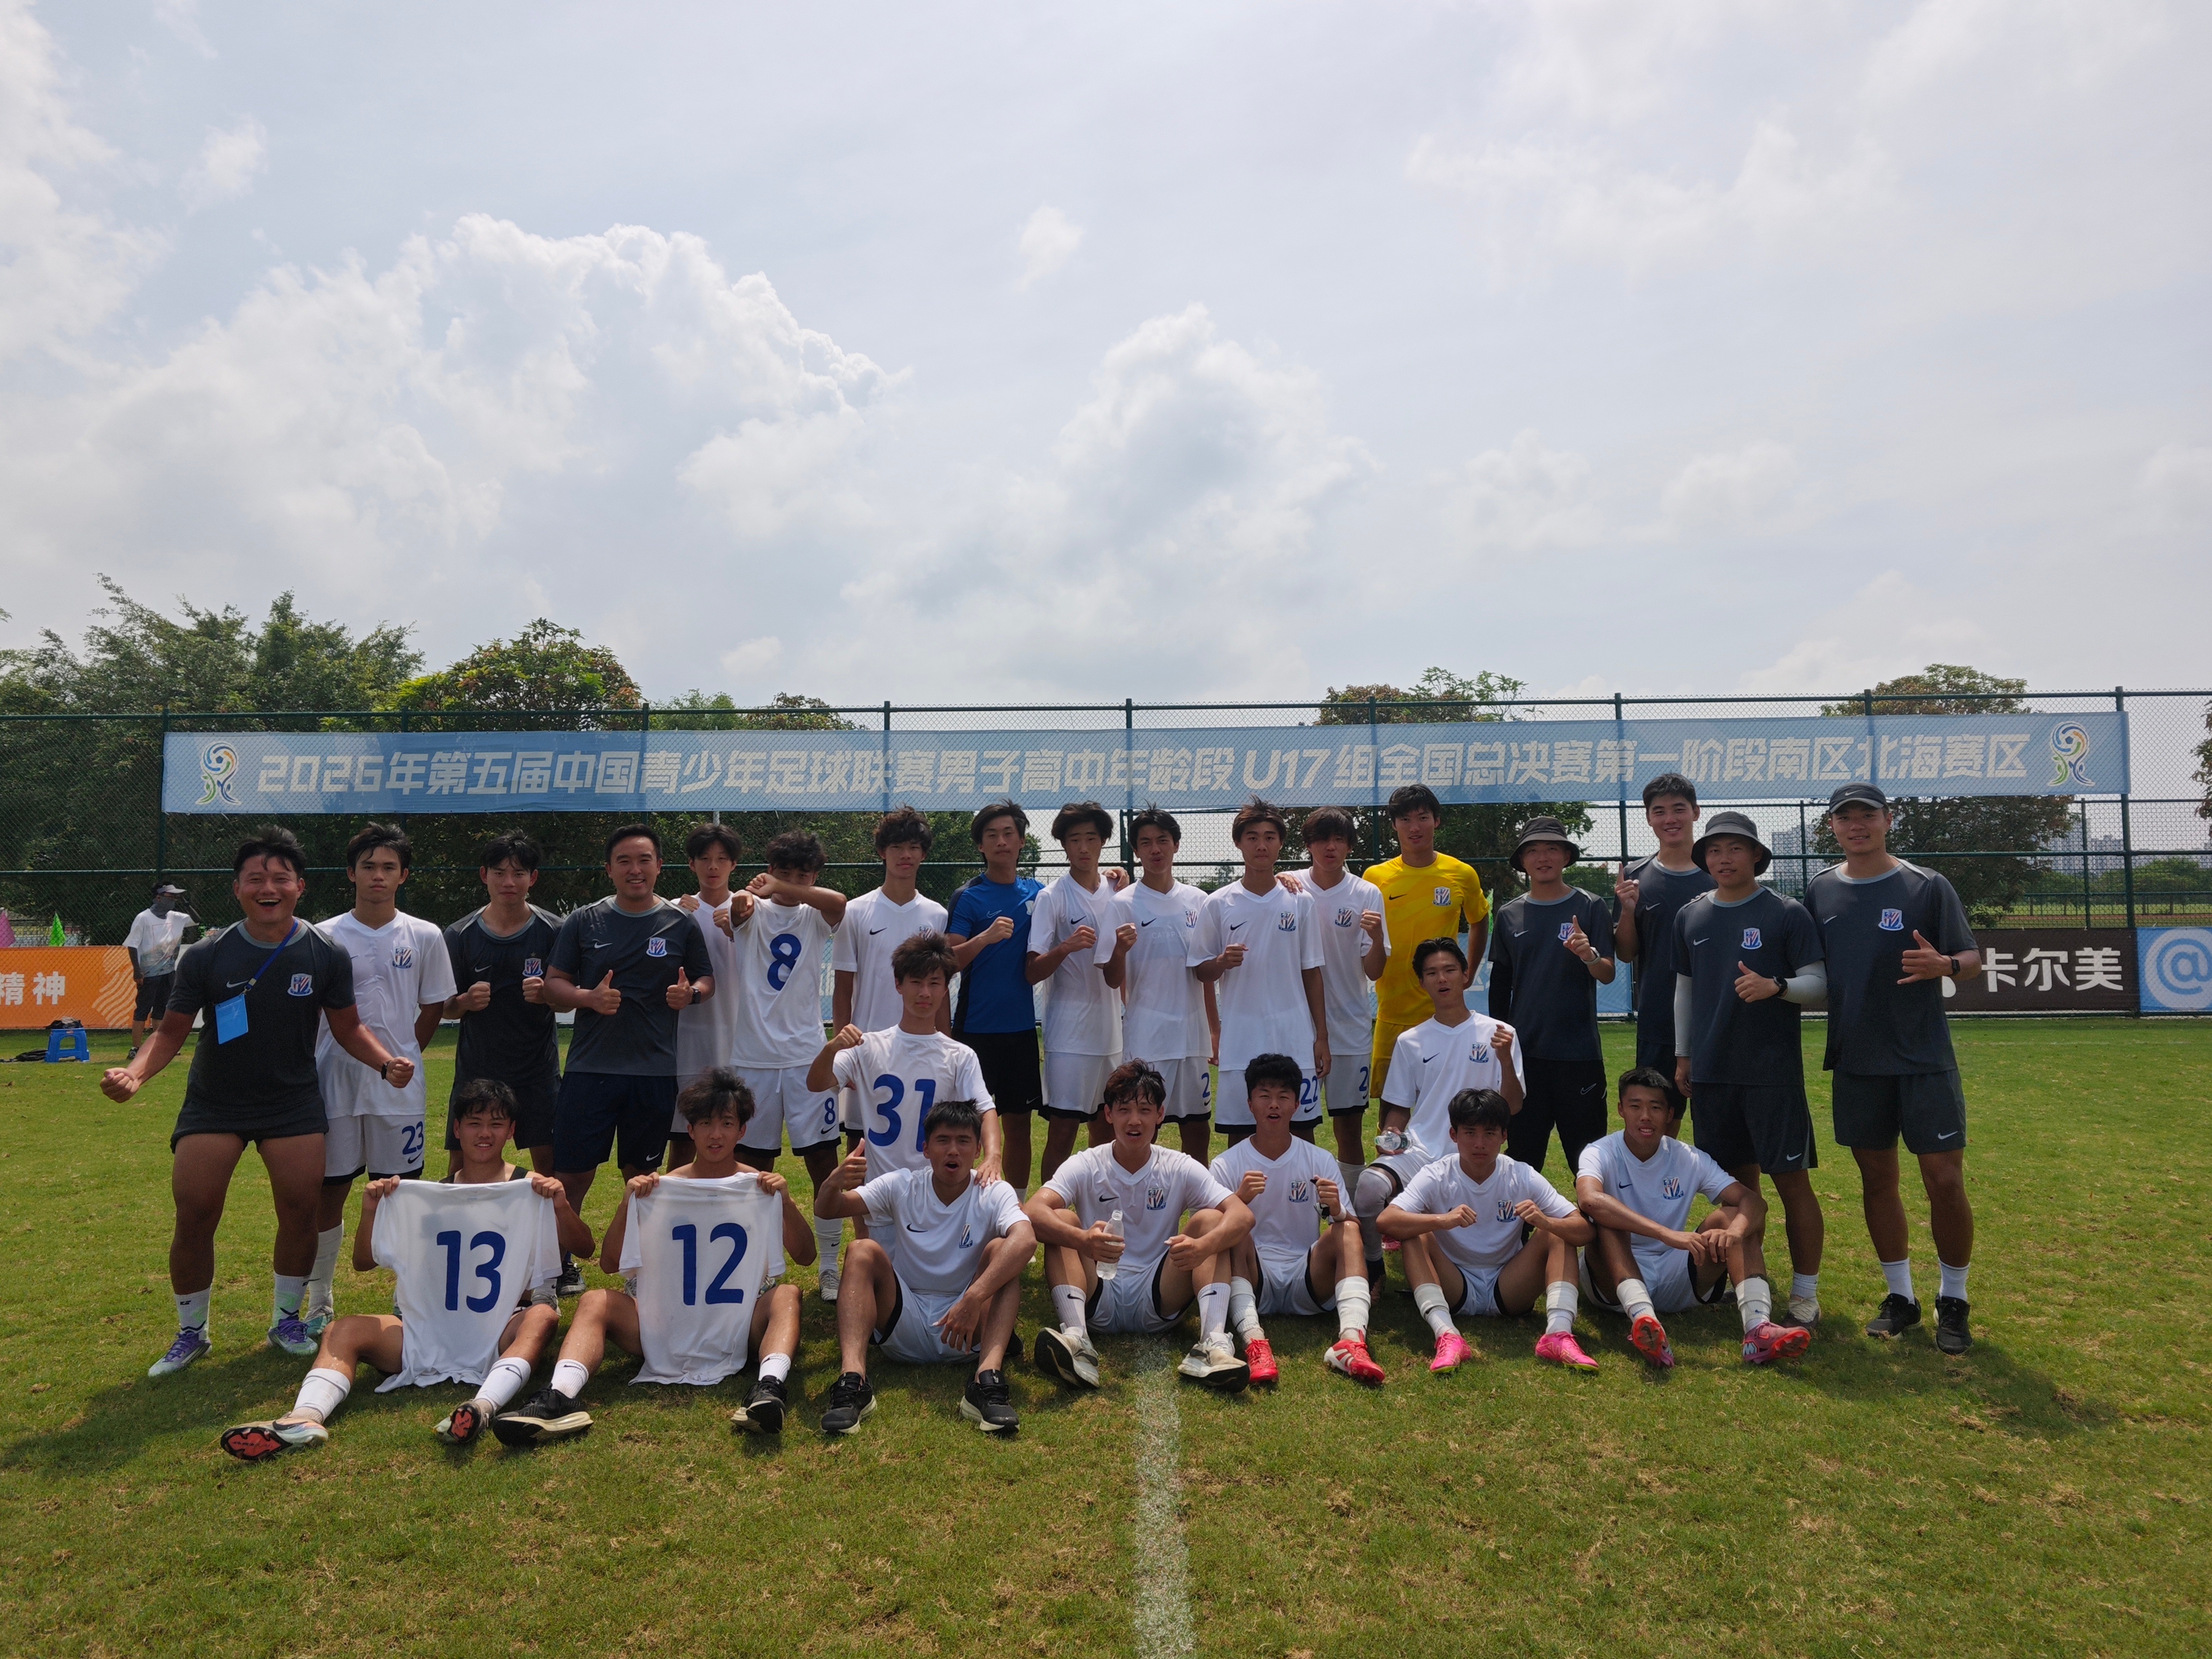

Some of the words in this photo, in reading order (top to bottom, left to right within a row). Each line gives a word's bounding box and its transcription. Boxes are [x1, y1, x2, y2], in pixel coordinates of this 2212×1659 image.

[767, 933, 802, 991] 8
[1981, 947, 2123, 992] 卡尔美
[402, 1121, 423, 1155] 23
[824, 1097, 835, 1124] 8
[868, 1074, 936, 1152] 31
[437, 1230, 505, 1313] 13
[672, 1223, 747, 1306] 12
